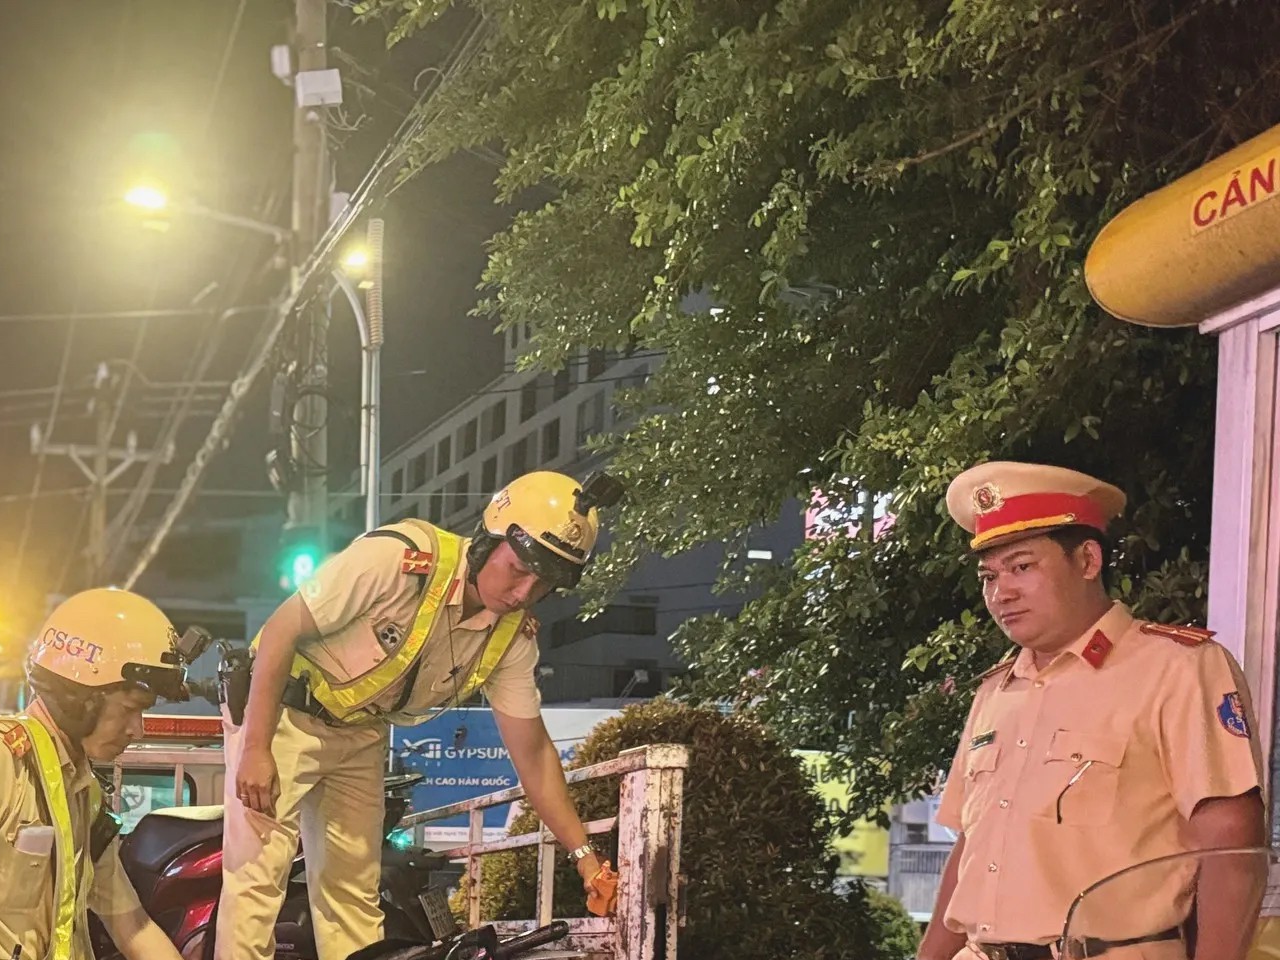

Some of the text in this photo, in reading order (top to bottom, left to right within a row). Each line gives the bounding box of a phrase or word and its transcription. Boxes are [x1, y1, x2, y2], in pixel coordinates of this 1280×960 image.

[42, 627, 104, 664] CSGT
[444, 747, 511, 760] GYPSUM
[435, 777, 457, 787] CAO
[481, 774, 511, 787] QUỐC
